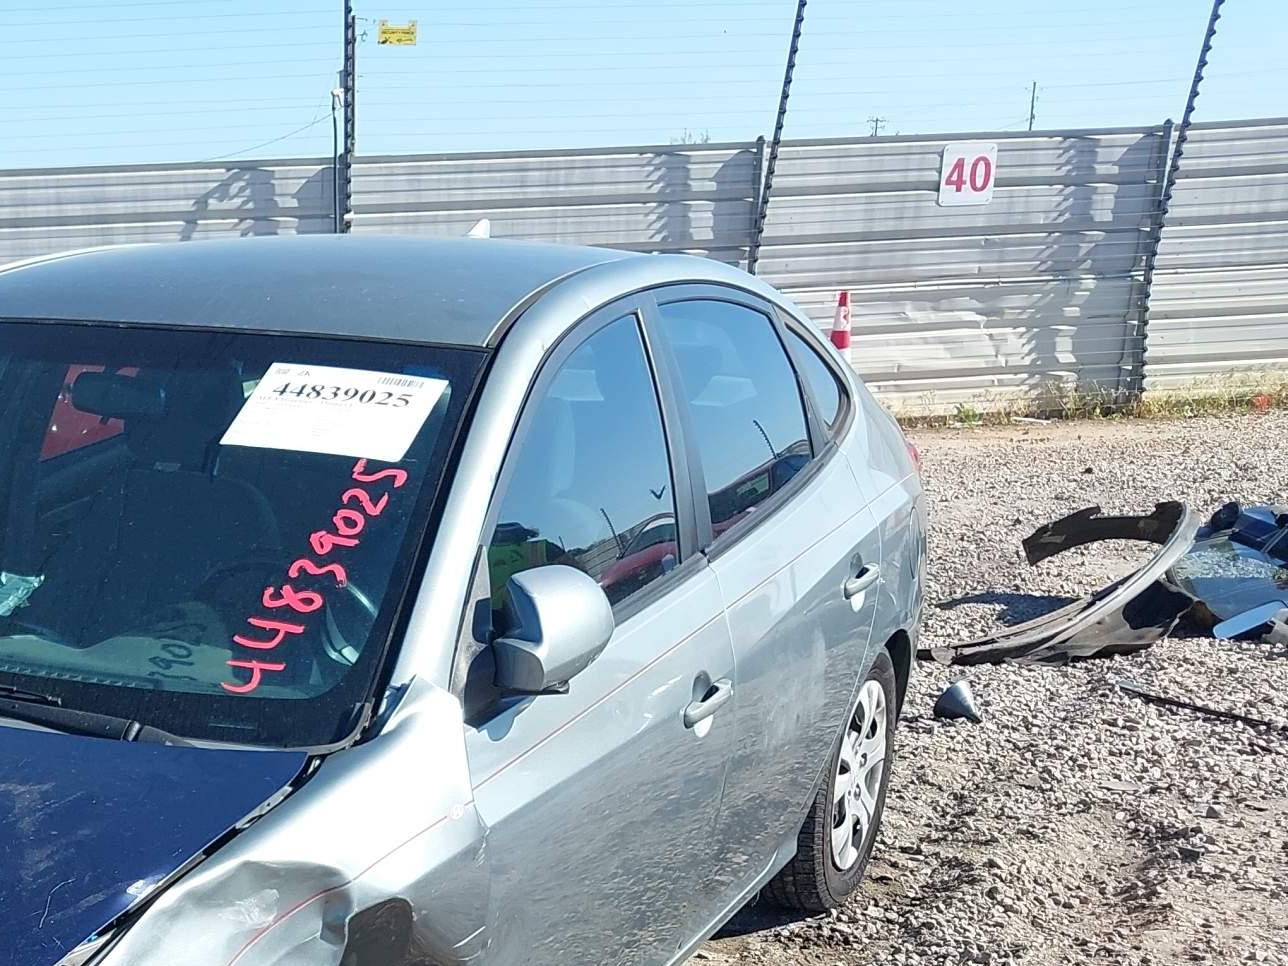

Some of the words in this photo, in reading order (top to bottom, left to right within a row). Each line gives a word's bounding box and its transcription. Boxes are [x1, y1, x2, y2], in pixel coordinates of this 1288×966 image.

[945, 156, 991, 192] 40
[272, 381, 414, 408] 44839025
[221, 458, 407, 693] 44839025
